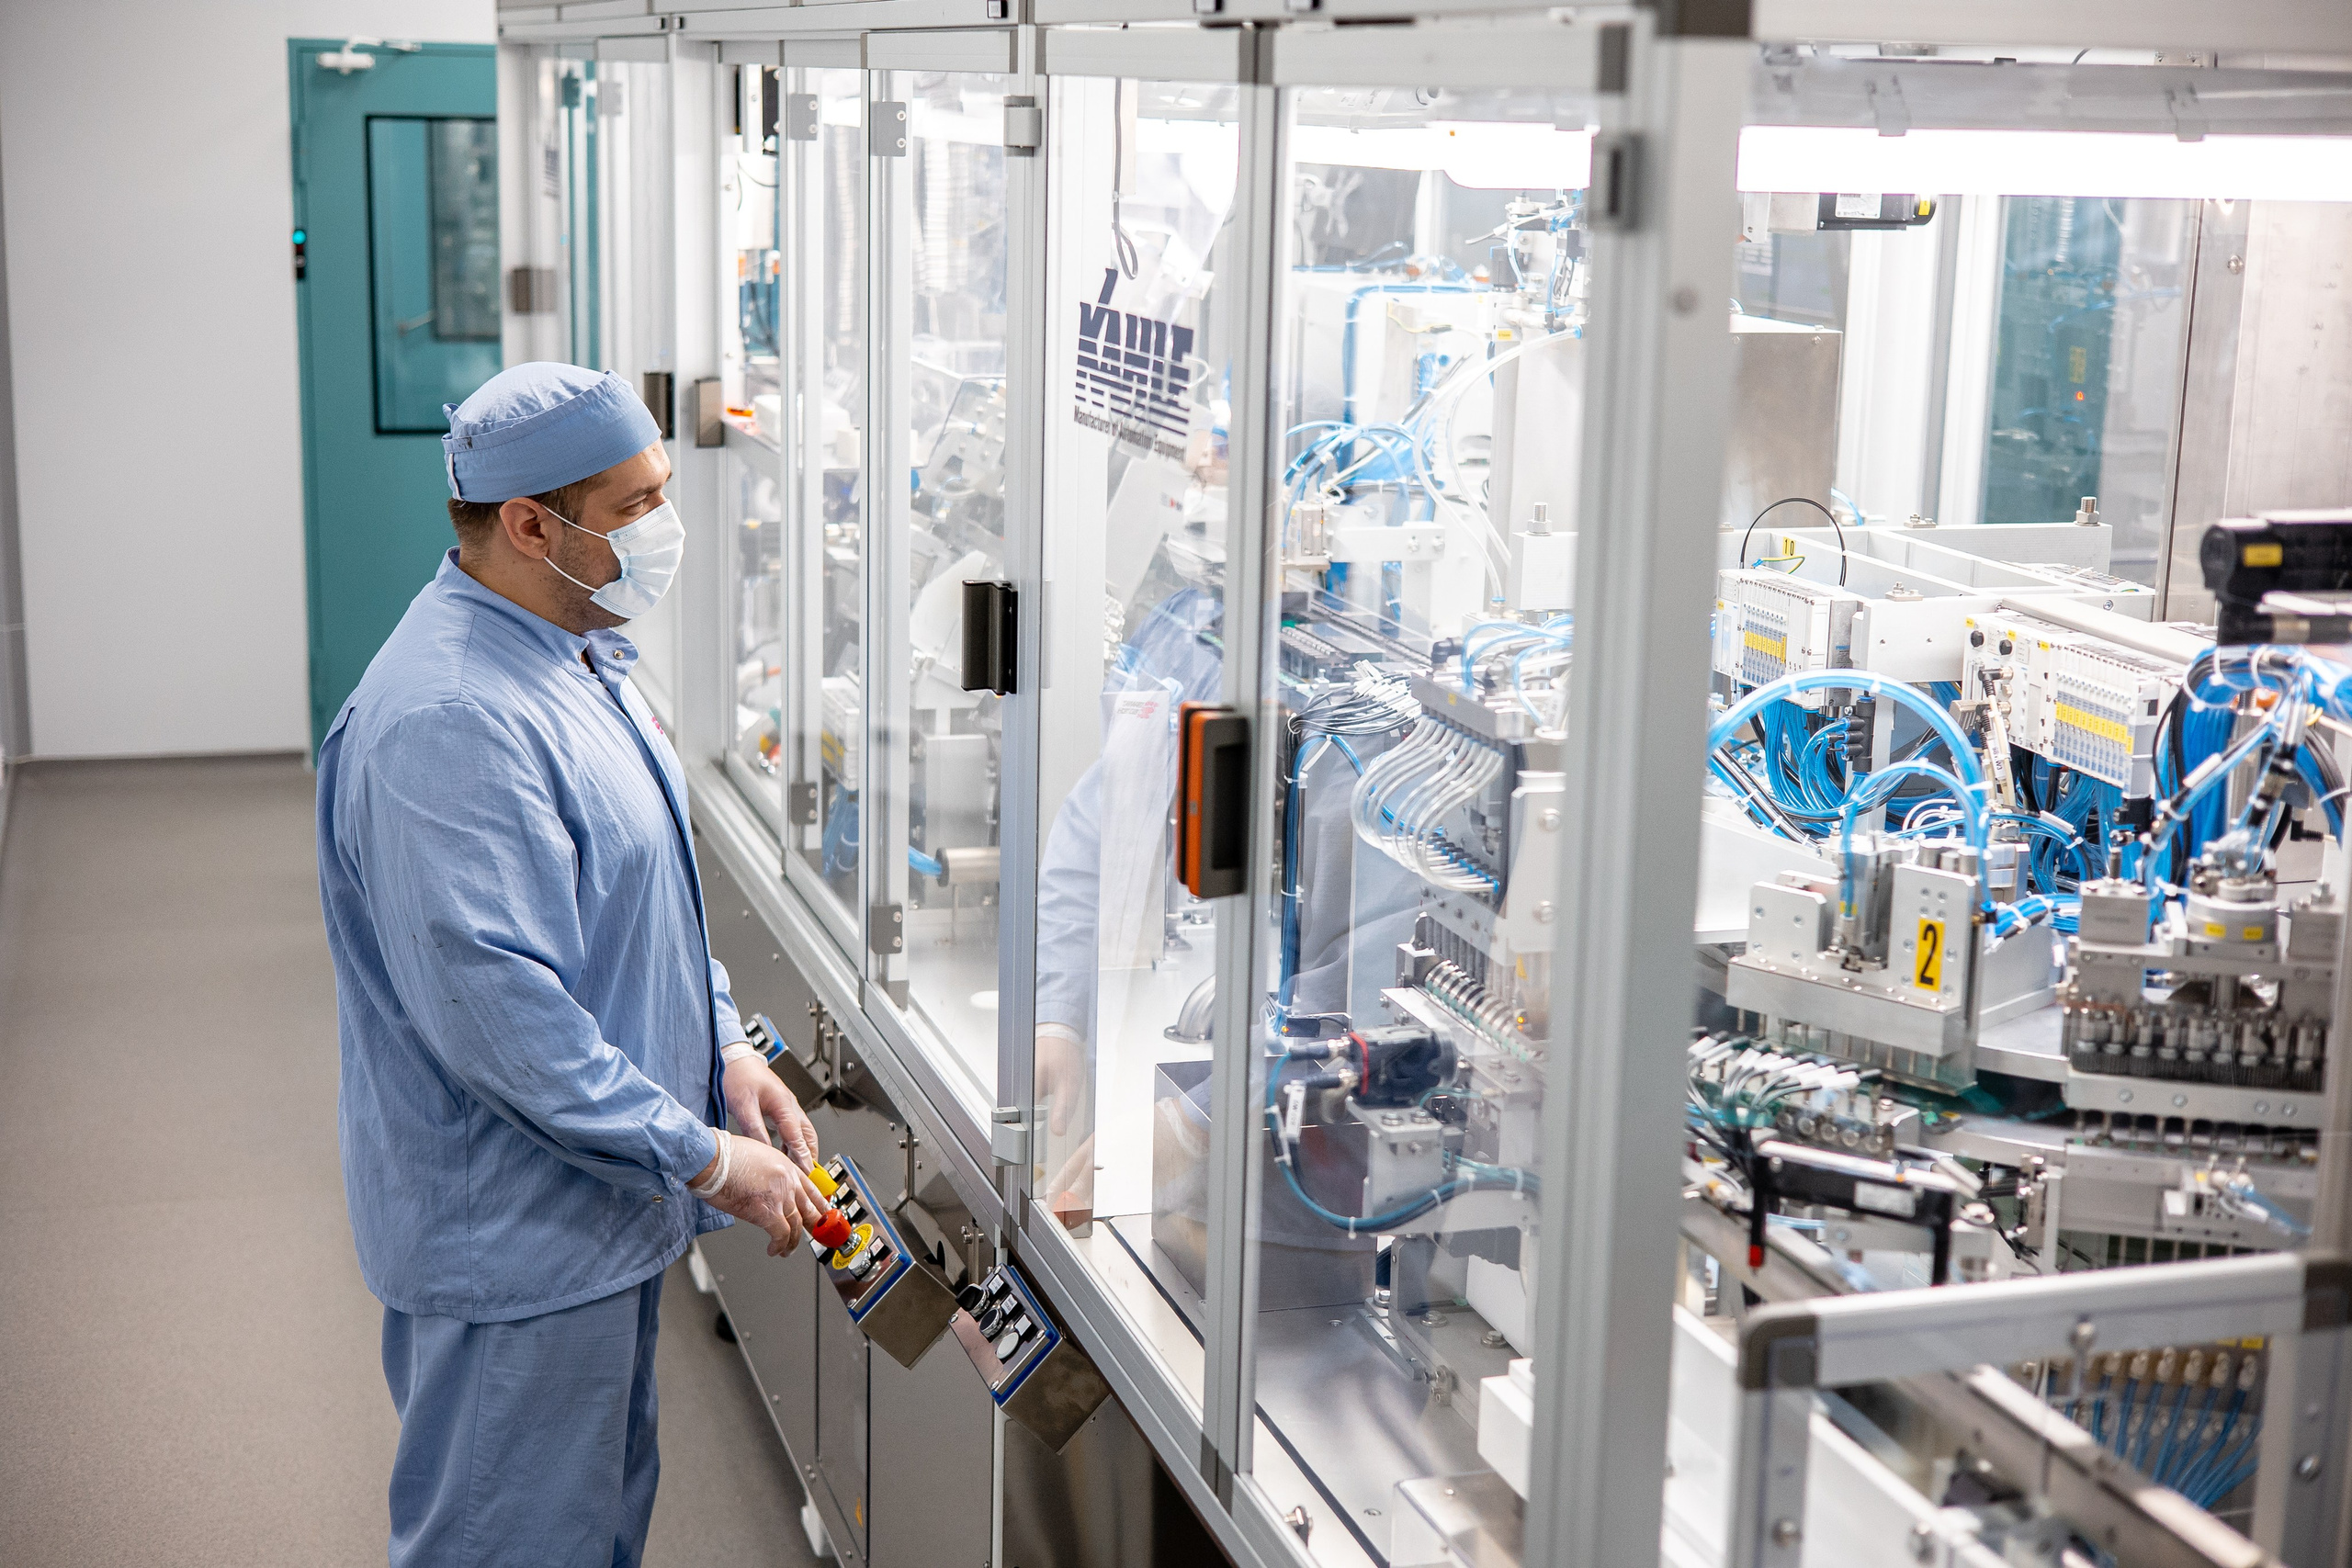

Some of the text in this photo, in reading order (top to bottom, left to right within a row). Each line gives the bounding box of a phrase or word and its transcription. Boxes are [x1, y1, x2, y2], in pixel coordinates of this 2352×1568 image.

[1073, 405, 1111, 434] Manufacturer
[1154, 434, 1186, 463] Equipment
[1784, 538, 1795, 557] 10
[1920, 924, 1938, 987] 2
